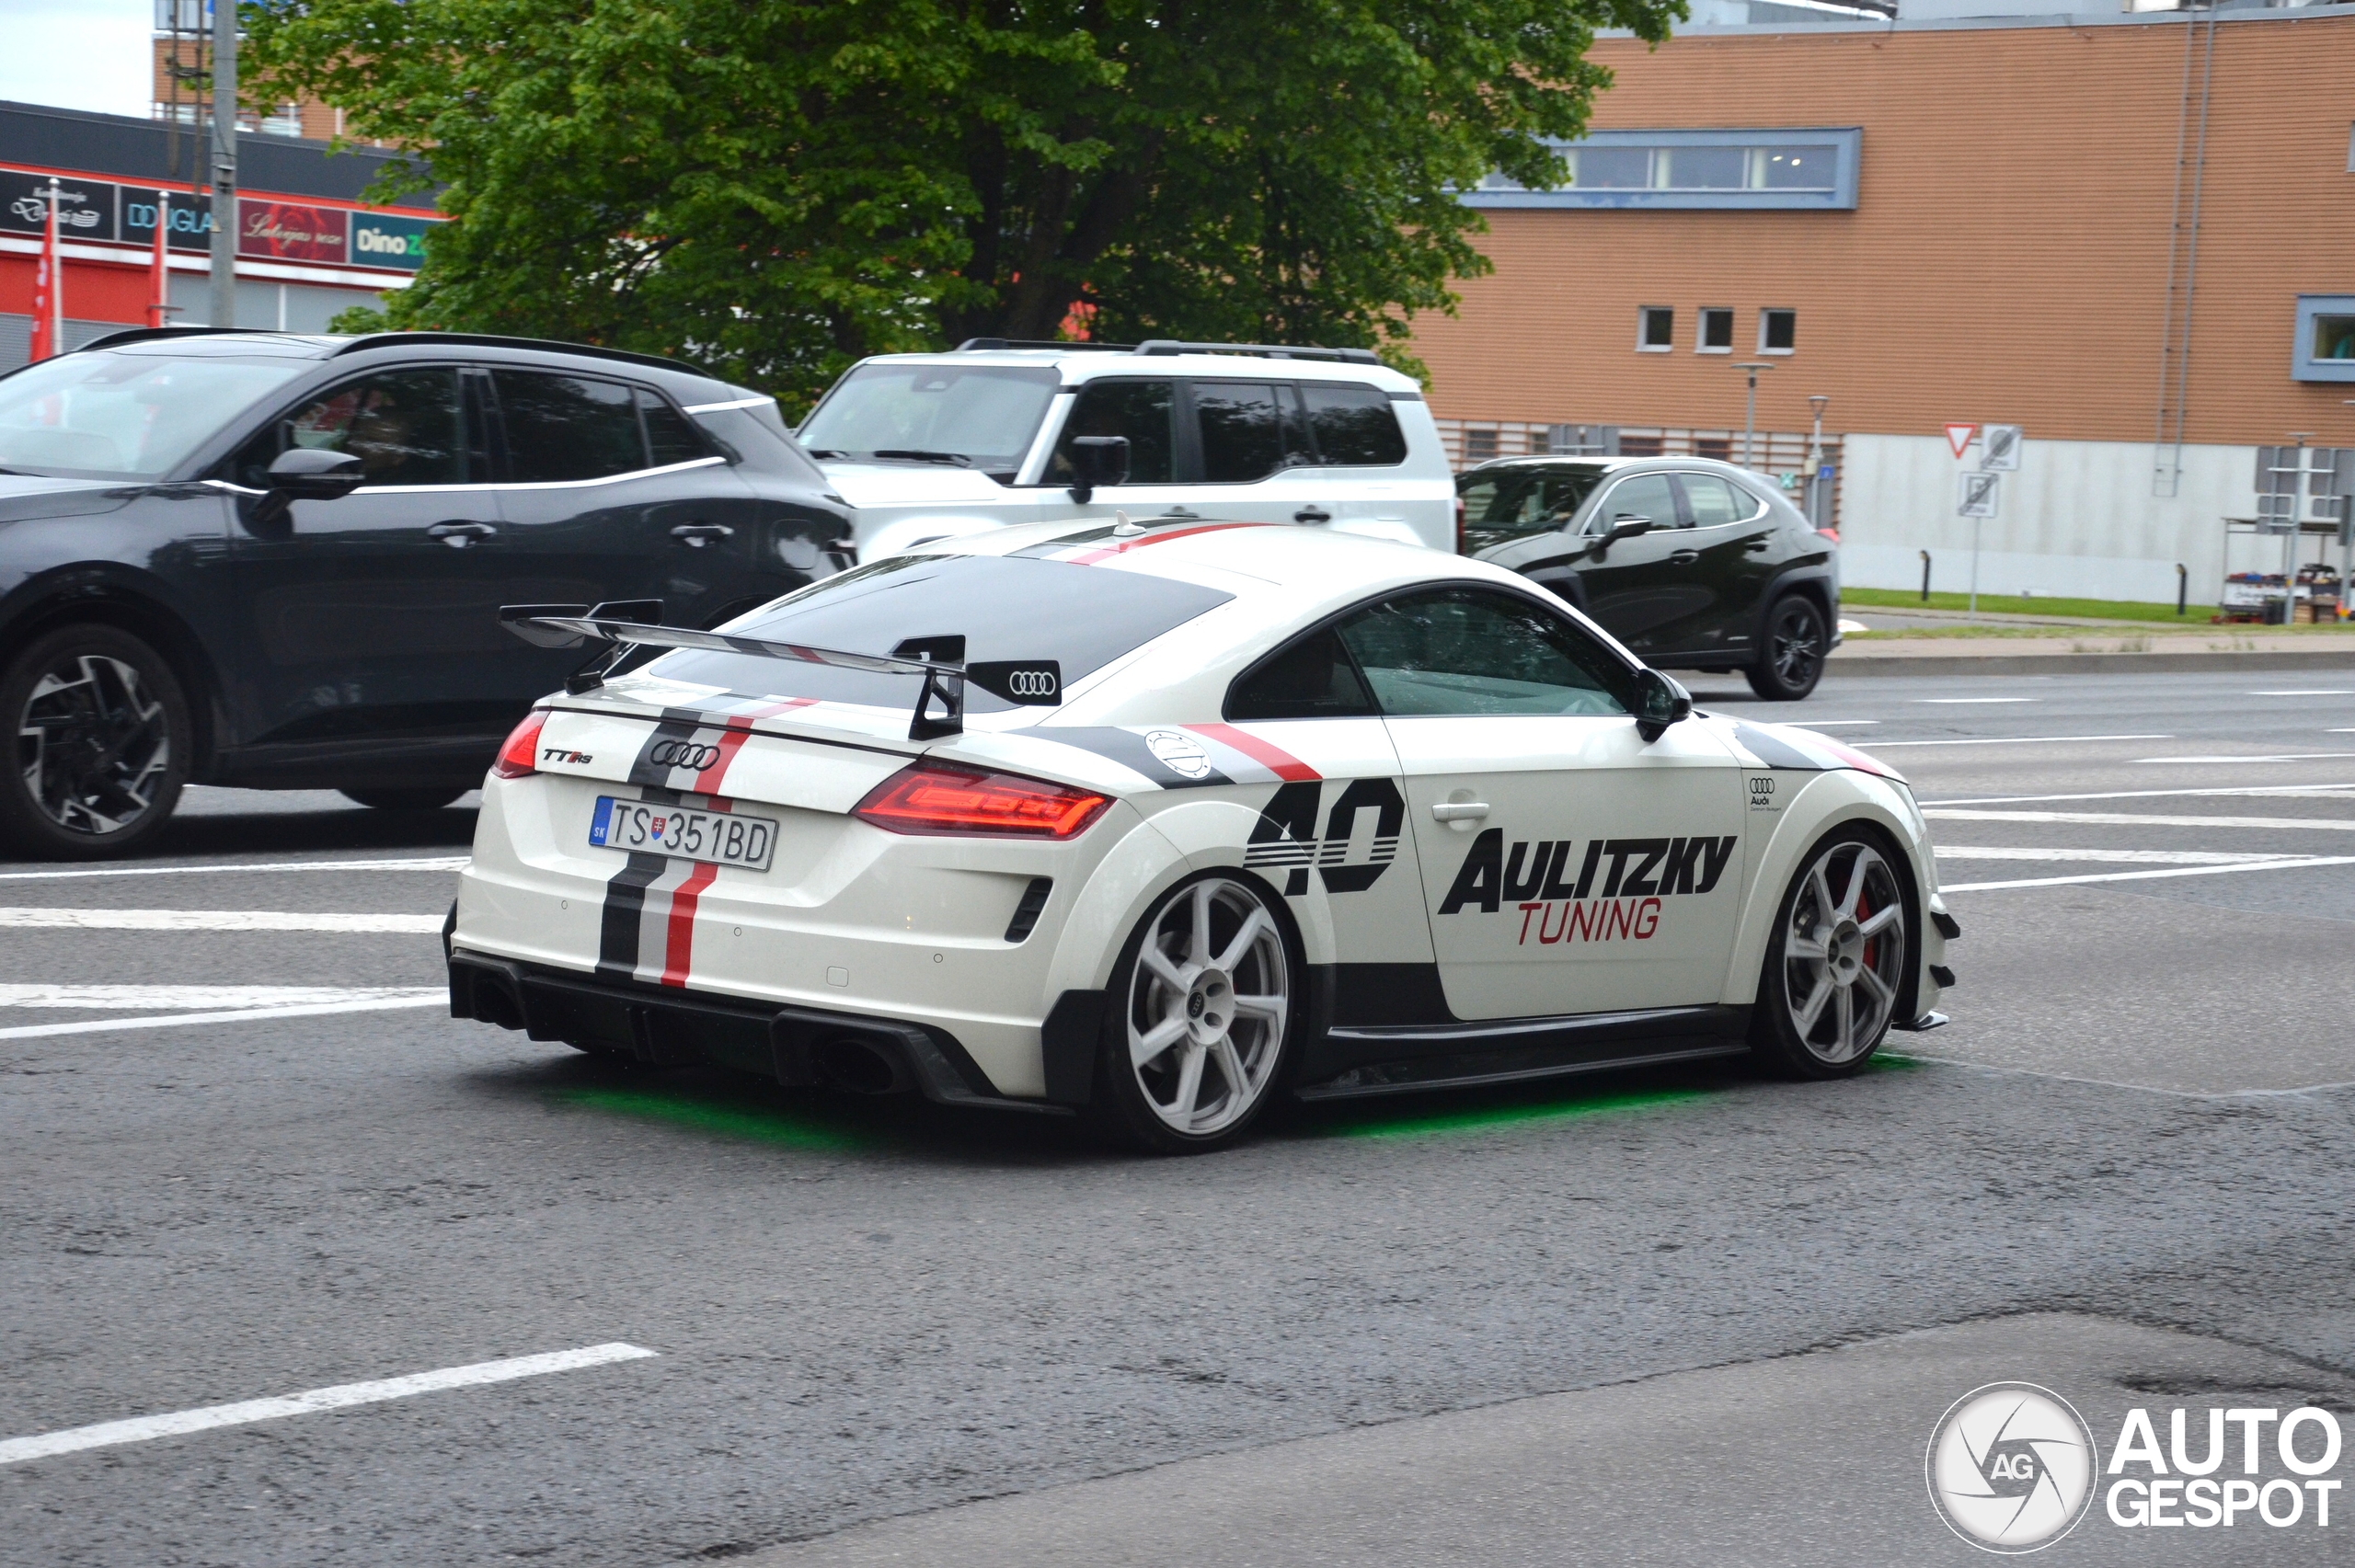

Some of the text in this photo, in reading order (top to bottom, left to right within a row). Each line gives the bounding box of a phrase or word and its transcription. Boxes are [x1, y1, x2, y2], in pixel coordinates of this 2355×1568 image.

[1750, 795, 1770, 806] Audi
[593, 826, 605, 839] SK
[1518, 898, 1661, 945] TUNING
